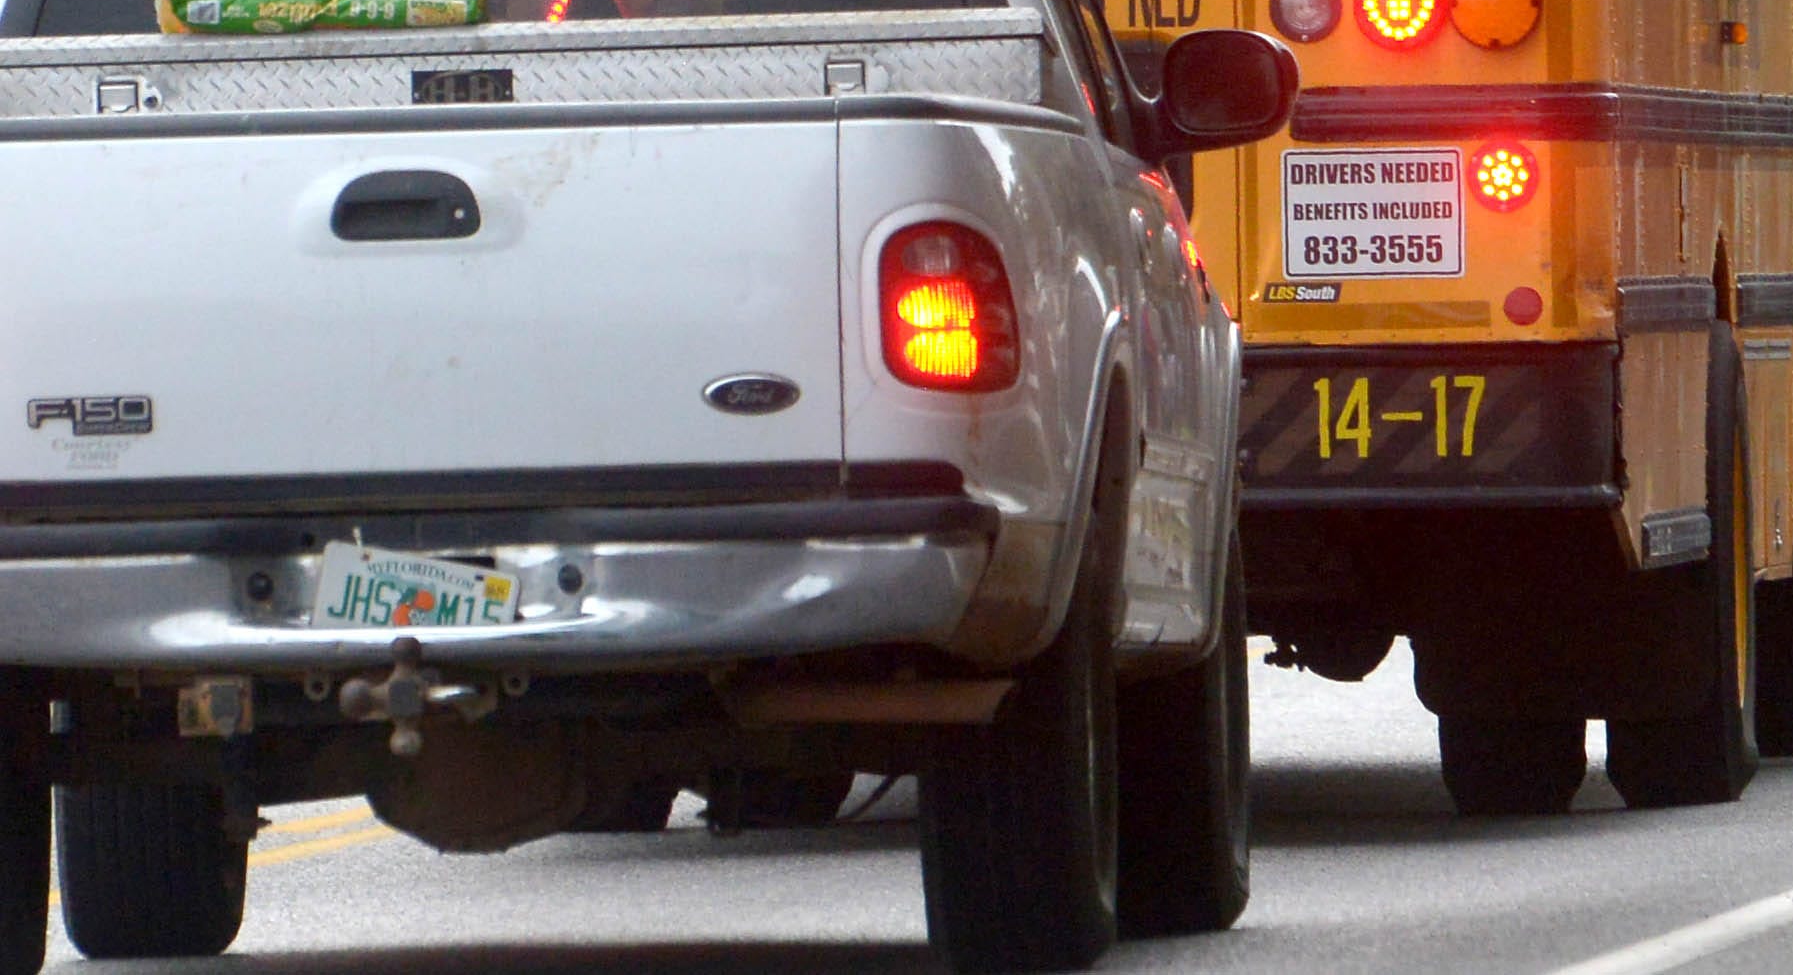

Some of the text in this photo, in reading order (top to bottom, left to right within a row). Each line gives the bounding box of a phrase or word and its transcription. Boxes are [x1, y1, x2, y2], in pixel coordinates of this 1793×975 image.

[1291, 161, 1454, 186] DRIVERS NEEDED
[1293, 201, 1453, 222] BENEFITS INCLUDED
[1303, 234, 1443, 266] 833-3555
[1313, 376, 1485, 458] 14-17
[327, 575, 395, 626] JHS
